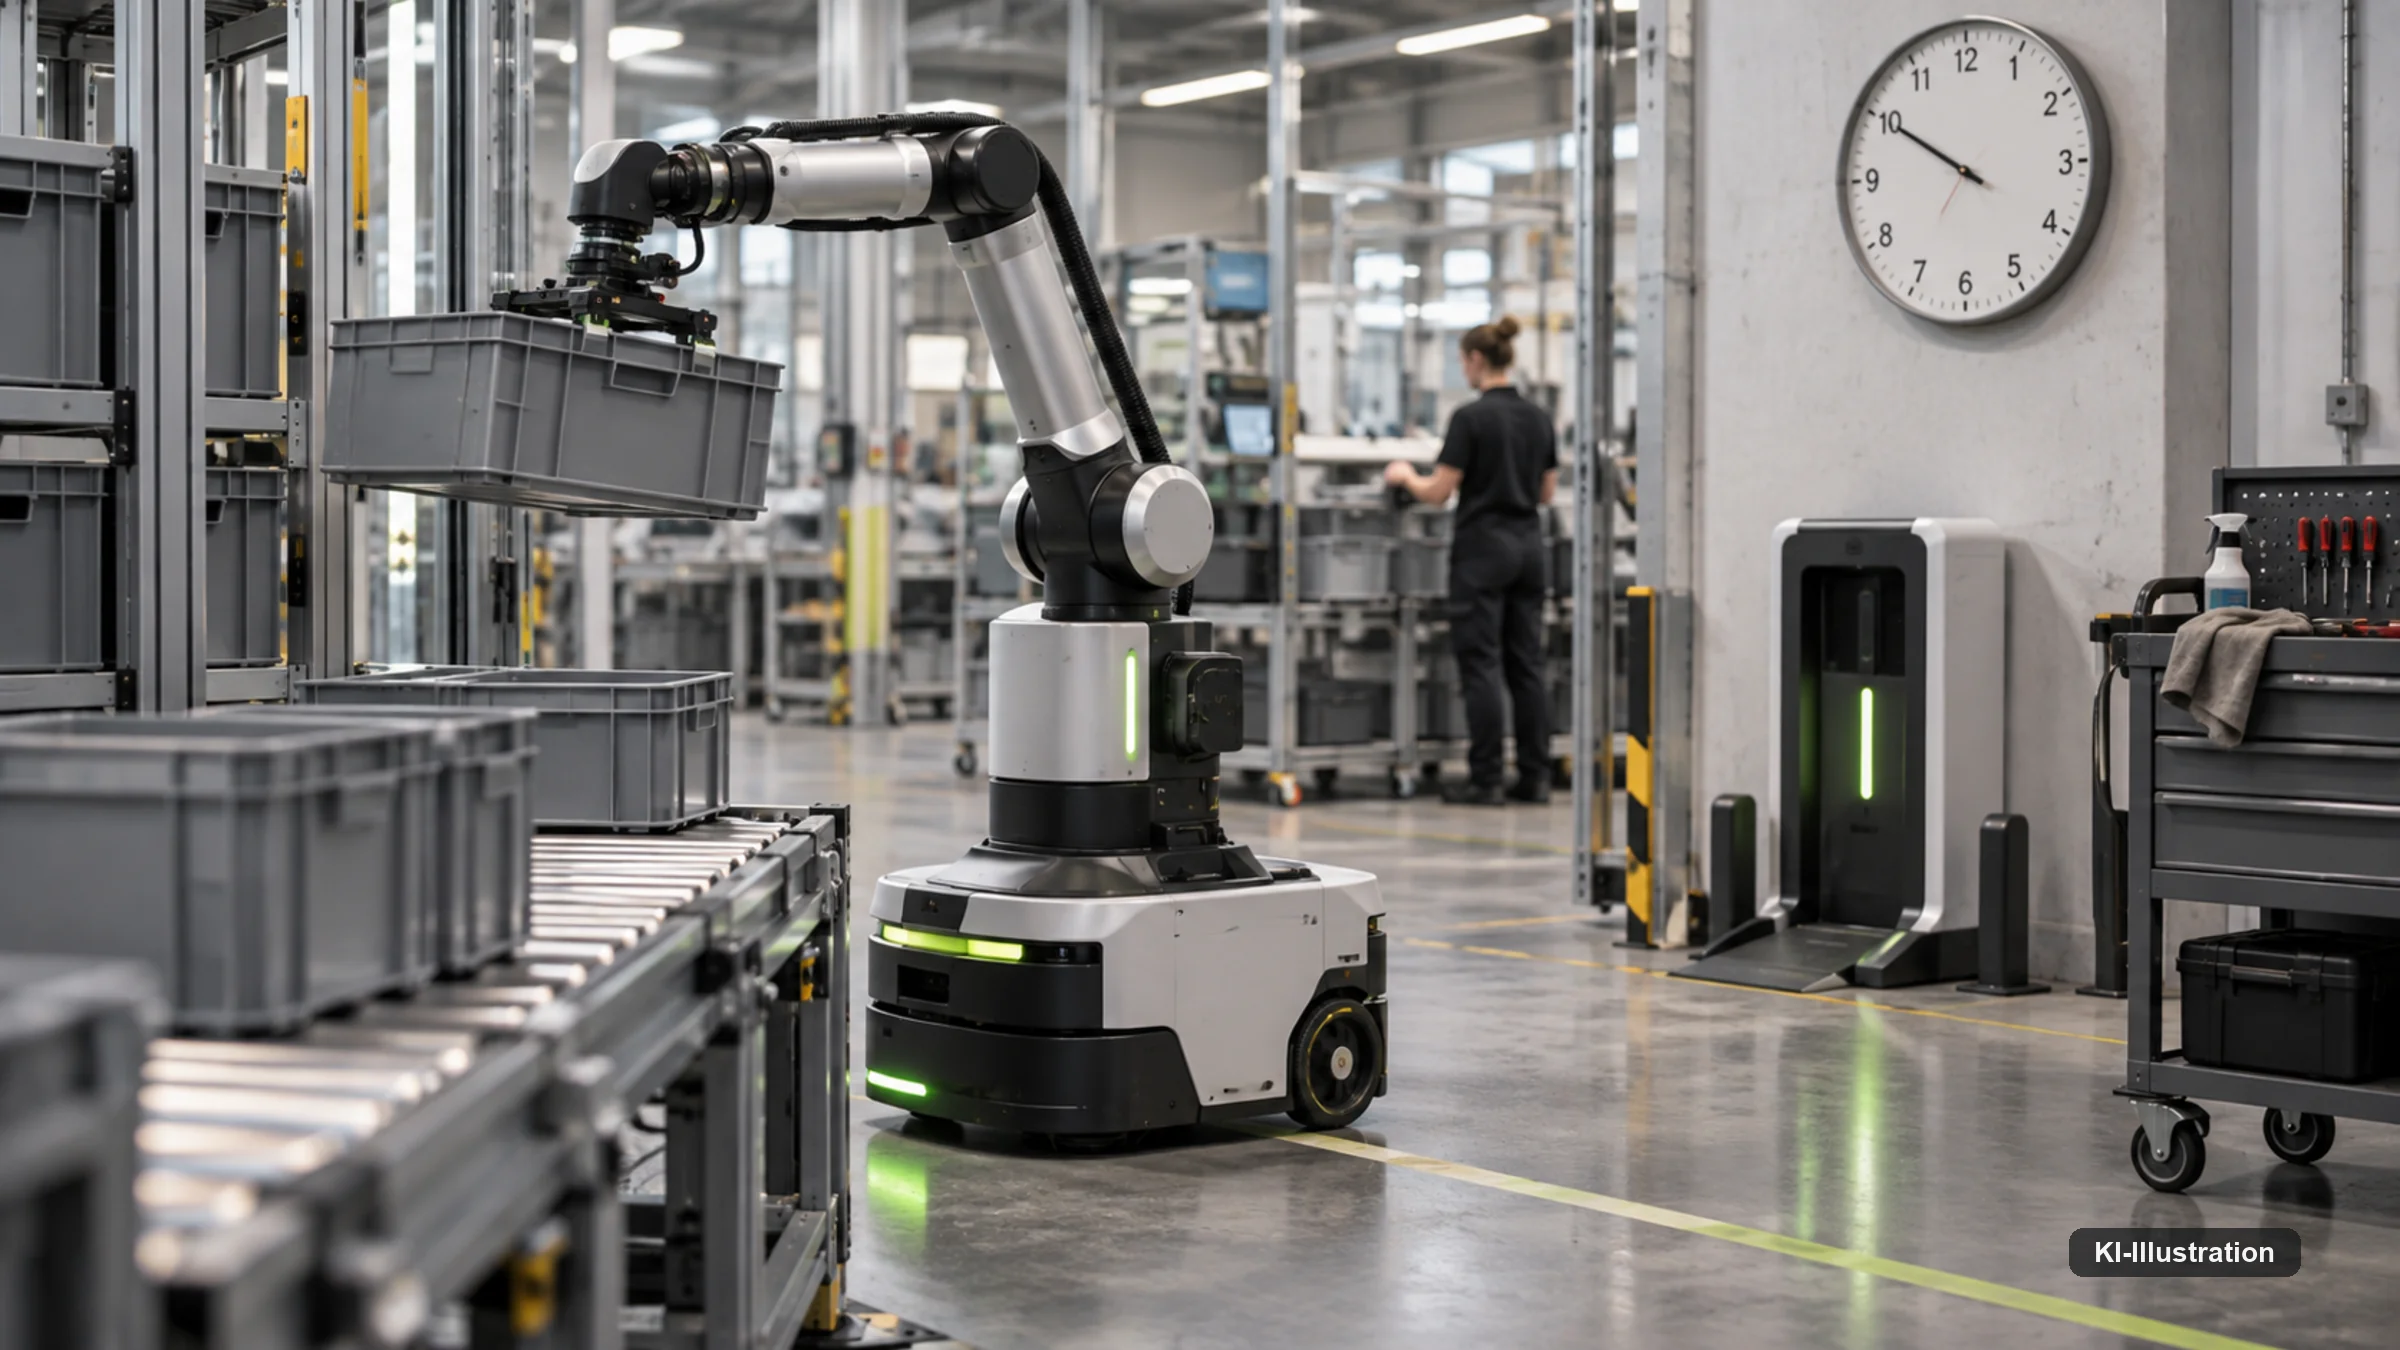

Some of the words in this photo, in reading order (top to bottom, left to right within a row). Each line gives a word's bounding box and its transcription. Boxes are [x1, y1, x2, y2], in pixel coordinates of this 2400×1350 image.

[1954, 46, 1978, 73] 12
[2009, 54, 2018, 81] 1
[1911, 67, 1930, 92] 11
[2043, 90, 2058, 117] 2
[1878, 109, 1901, 135] 10
[2058, 148, 2073, 176] 3
[1865, 167, 1880, 193] 9
[2041, 208, 2058, 234] 4
[1878, 222, 1893, 248] 8
[1913, 259, 1927, 284] 7
[2007, 253, 2022, 279] 5
[1958, 270, 1973, 296] 6
